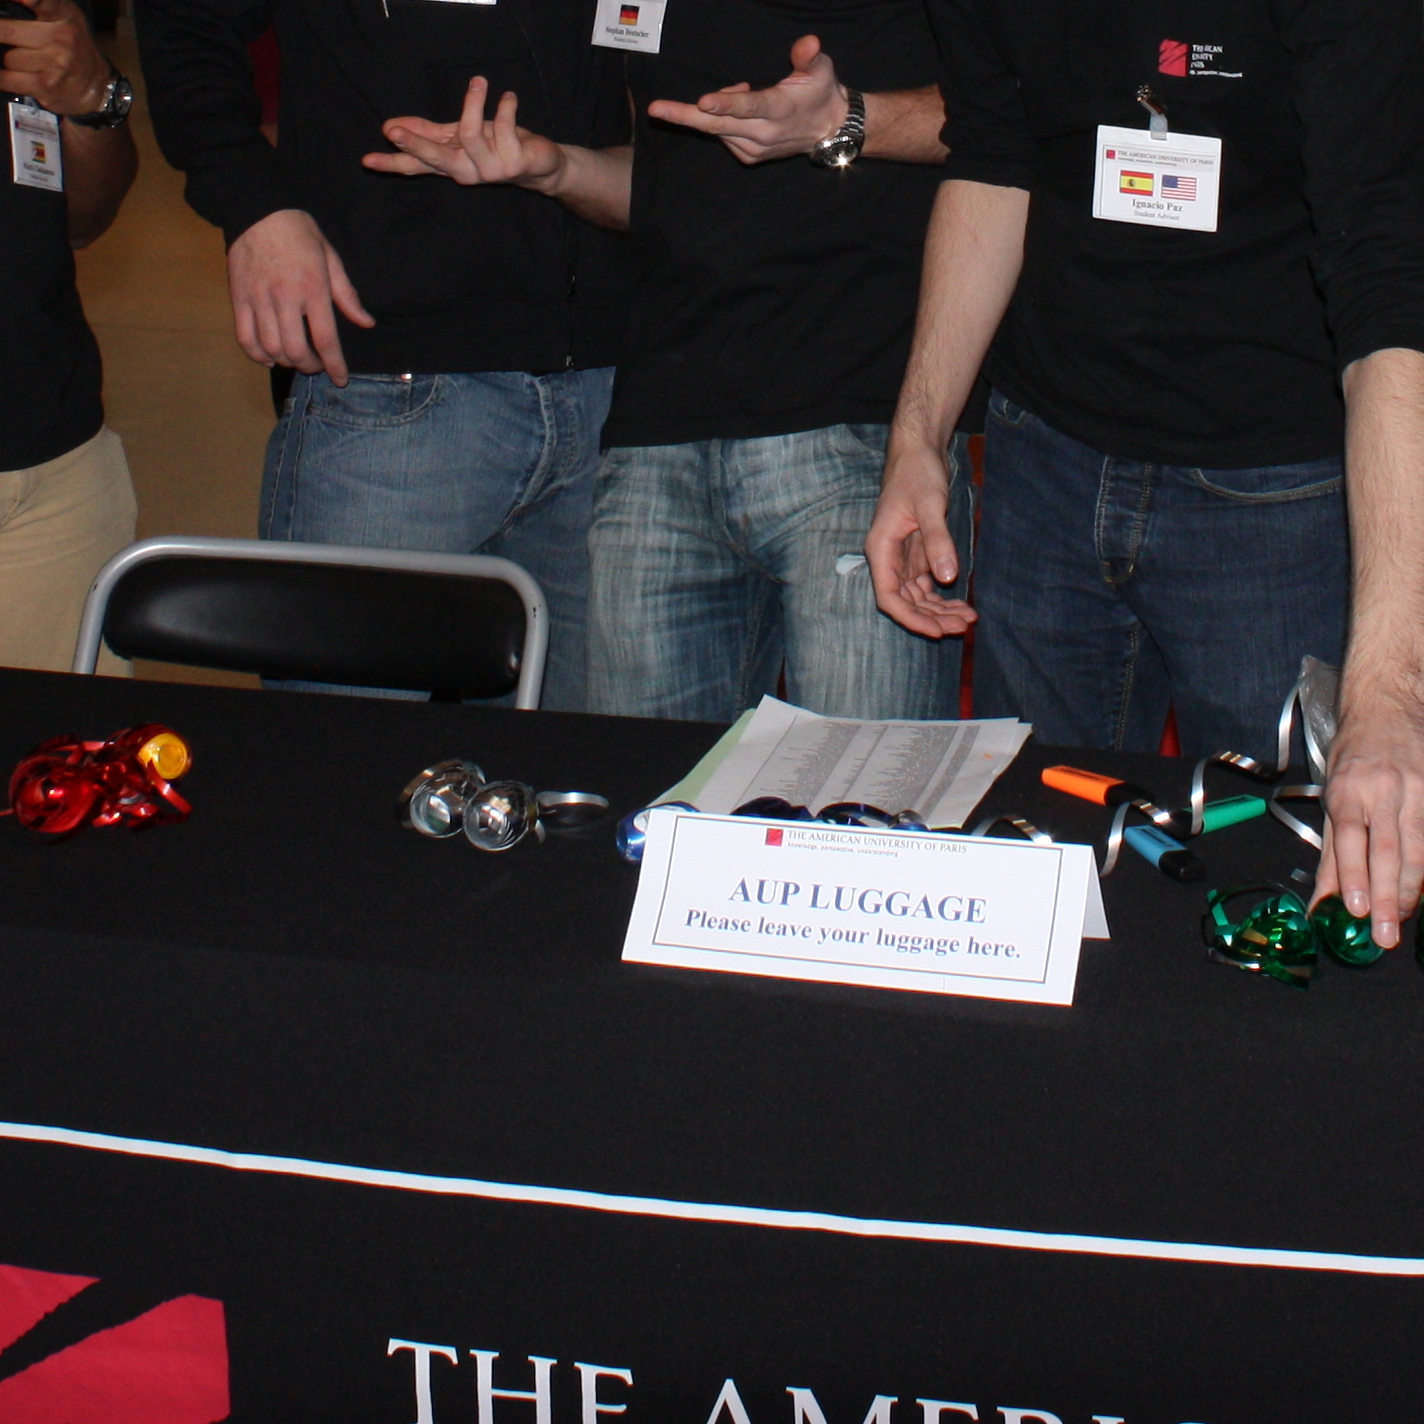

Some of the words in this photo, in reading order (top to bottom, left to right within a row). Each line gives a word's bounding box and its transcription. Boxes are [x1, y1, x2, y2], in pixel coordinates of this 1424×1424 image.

[787, 829, 807, 840] THE
[809, 831, 861, 845] AMERICAN
[863, 836, 923, 851] UNIVERSITY
[924, 841, 939, 851] OF
[940, 843, 968, 854] PARIS
[728, 876, 801, 907] AUP
[808, 883, 988, 924] LUGGAGE
[685, 908, 752, 933] Please
[757, 916, 813, 939] leave
[817, 925, 871, 946] your
[876, 927, 961, 957] luggage
[966, 935, 1021, 959] here.
[387, 1337, 635, 1424] THE
